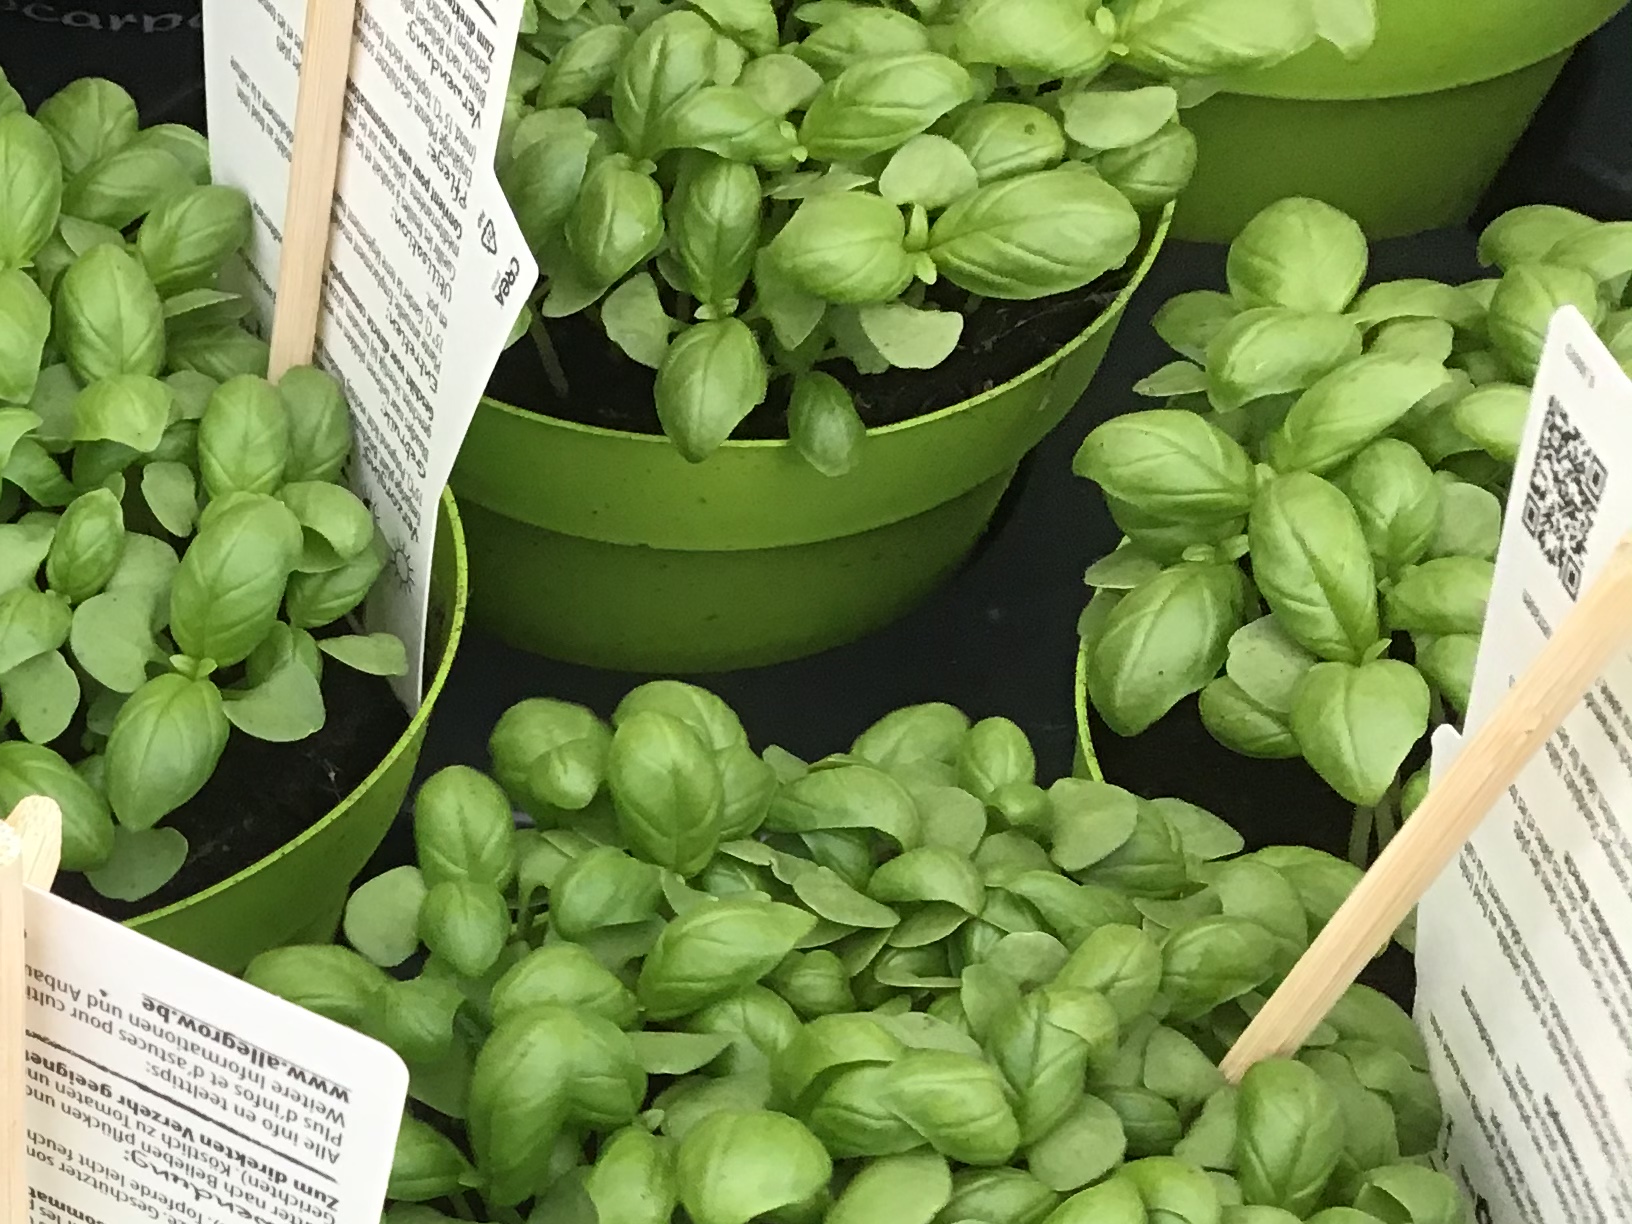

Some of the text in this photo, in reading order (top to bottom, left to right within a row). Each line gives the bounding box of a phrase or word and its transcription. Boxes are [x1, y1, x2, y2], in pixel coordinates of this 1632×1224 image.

[405, 19, 483, 128] Verwendung:
[426, 135, 468, 209] Pflege:
[390, 206, 451, 302] Utilisation:
[385, 307, 437, 393] Entretien:
[380, 401, 425, 478] Gebruik:
[25, 984, 65, 1011] culti
[70, 1007, 112, 1034] pour
[87, 993, 122, 1021] und
[128, 1013, 265, 1089] Informationen
[142, 993, 349, 1103] www.allegrow.be
[210, 1071, 228, 1088] et
[55, 1081, 130, 1129] Tomaten
[61, 1102, 135, 1150] pflücken
[116, 1095, 194, 1142] Verzehr
[146, 1061, 339, 1164] Alle info en teelttips:
[271, 1080, 344, 1127] Weitere
[27, 1128, 73, 1160] feuch
[136, 1120, 156, 1136] zu
[303, 1116, 342, 1146] Plus
[78, 1153, 124, 1187] leicht
[138, 1140, 217, 1189] Belieben
[161, 1132, 230, 1177] Köstlich
[199, 1133, 287, 1184] direkten
[58, 1162, 159, 1219] Geschützter
[224, 1181, 265, 1209] nach
[293, 1179, 338, 1211] Zum
